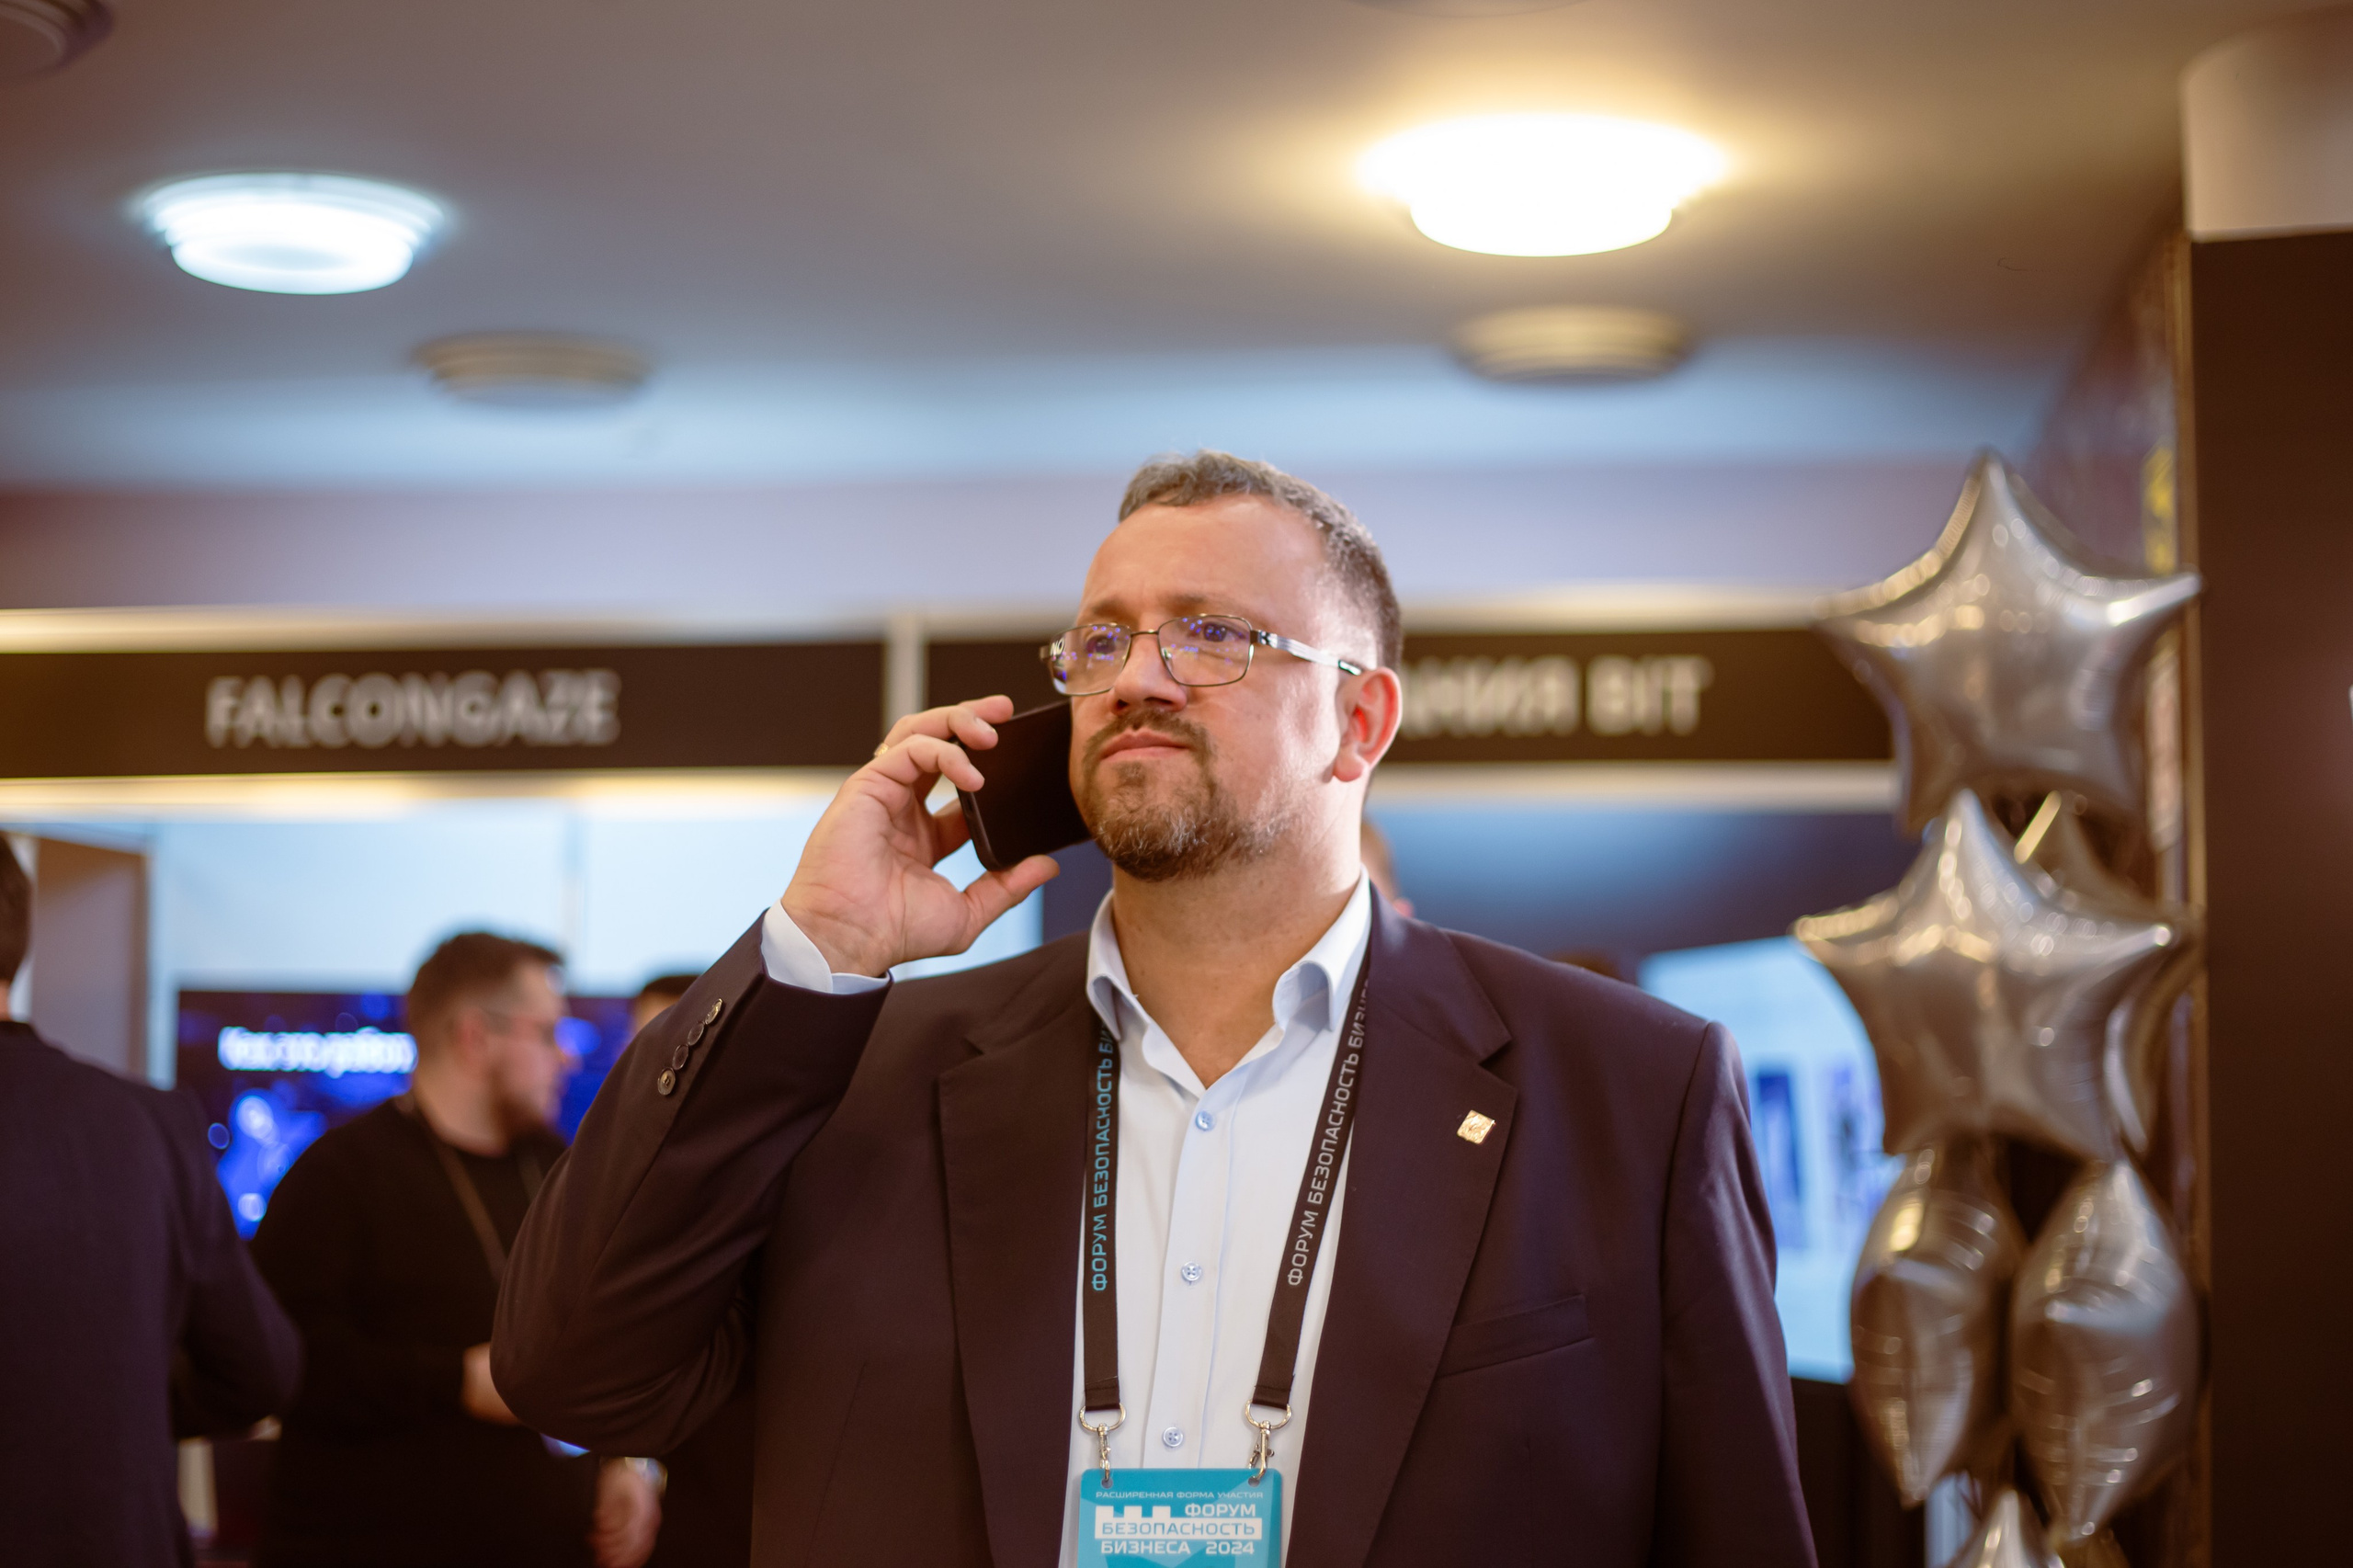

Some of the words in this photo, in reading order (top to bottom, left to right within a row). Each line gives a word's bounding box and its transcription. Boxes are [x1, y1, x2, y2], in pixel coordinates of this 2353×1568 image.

[205, 670, 621, 749] FALCONGAZE
[1093, 1058, 1113, 1209] БЕЗОПАСНОСТЬ
[1287, 1210, 1319, 1286] ФОРУМ
[1307, 1052, 1359, 1206] БЕЗОПАСНОСТЬ
[1091, 1213, 1108, 1291] ФОРУМ
[1095, 1491, 1174, 1499] РАСШИРЕННАЯ
[1176, 1491, 1215, 1499] ФОРМА
[1217, 1491, 1264, 1499] УЧАСТИЯ
[1184, 1503, 1256, 1517] ФОРУМ
[1100, 1540, 1191, 1554] БИЗНЕСА
[1205, 1540, 1256, 1555] 2024
[1101, 1522, 1256, 1536] БЕЗОПАСНОСТЬ
